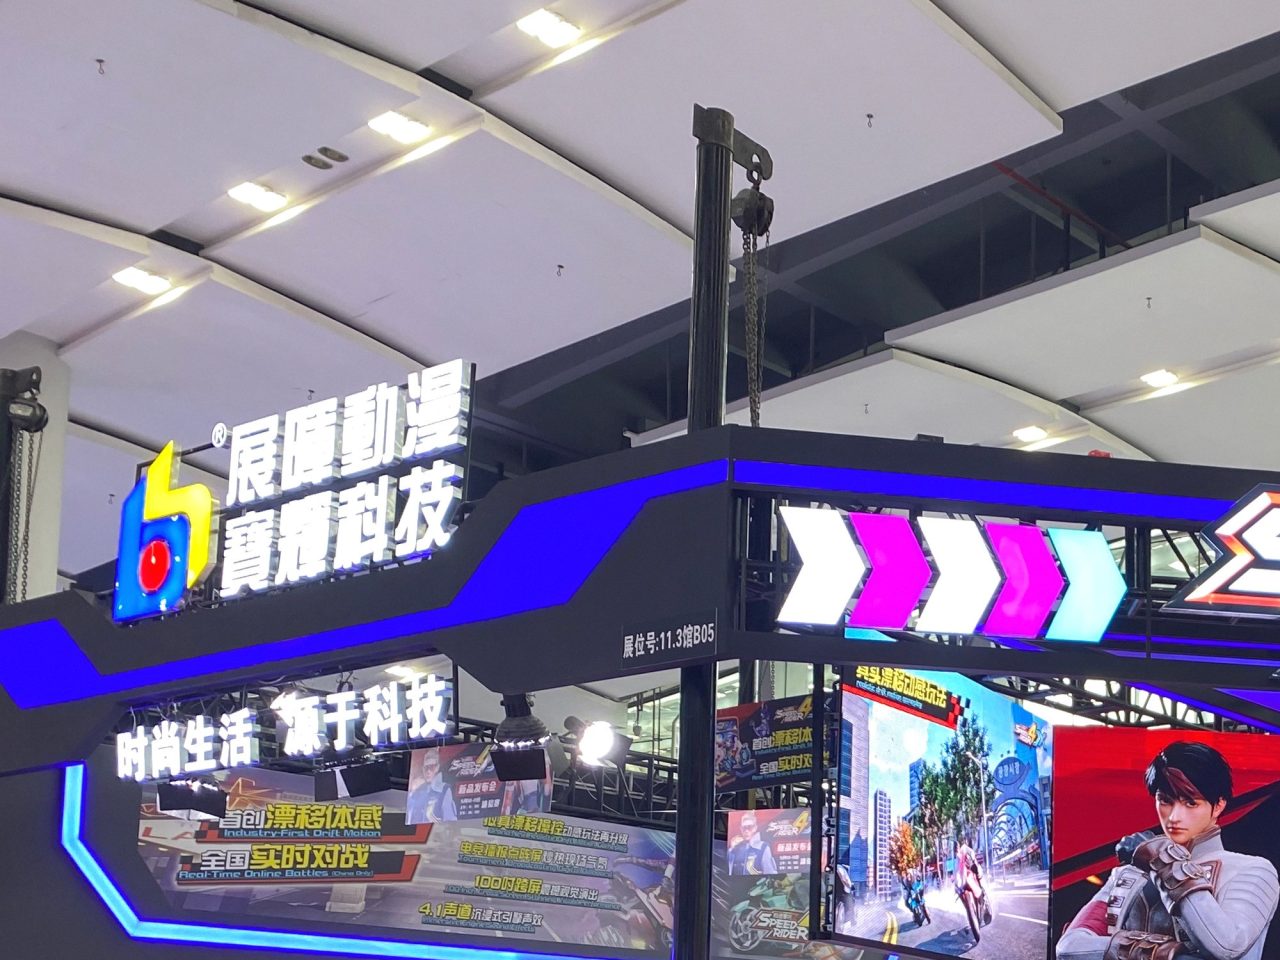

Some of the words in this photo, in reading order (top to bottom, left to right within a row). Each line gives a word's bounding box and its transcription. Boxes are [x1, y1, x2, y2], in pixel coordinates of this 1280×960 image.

[117, 707, 253, 781] 时尚生活
[219, 804, 384, 830] 首创漂移体感
[224, 828, 310, 839] Industry-First
[313, 828, 340, 838] Drift
[343, 828, 381, 838] Motion
[200, 844, 370, 871] 全国实时对战
[179, 870, 241, 880] Real-Time
[244, 870, 282, 879] Online
[285, 869, 329, 878] Battles
[758, 913, 798, 929] SPEED
[773, 925, 809, 941] RIDER
